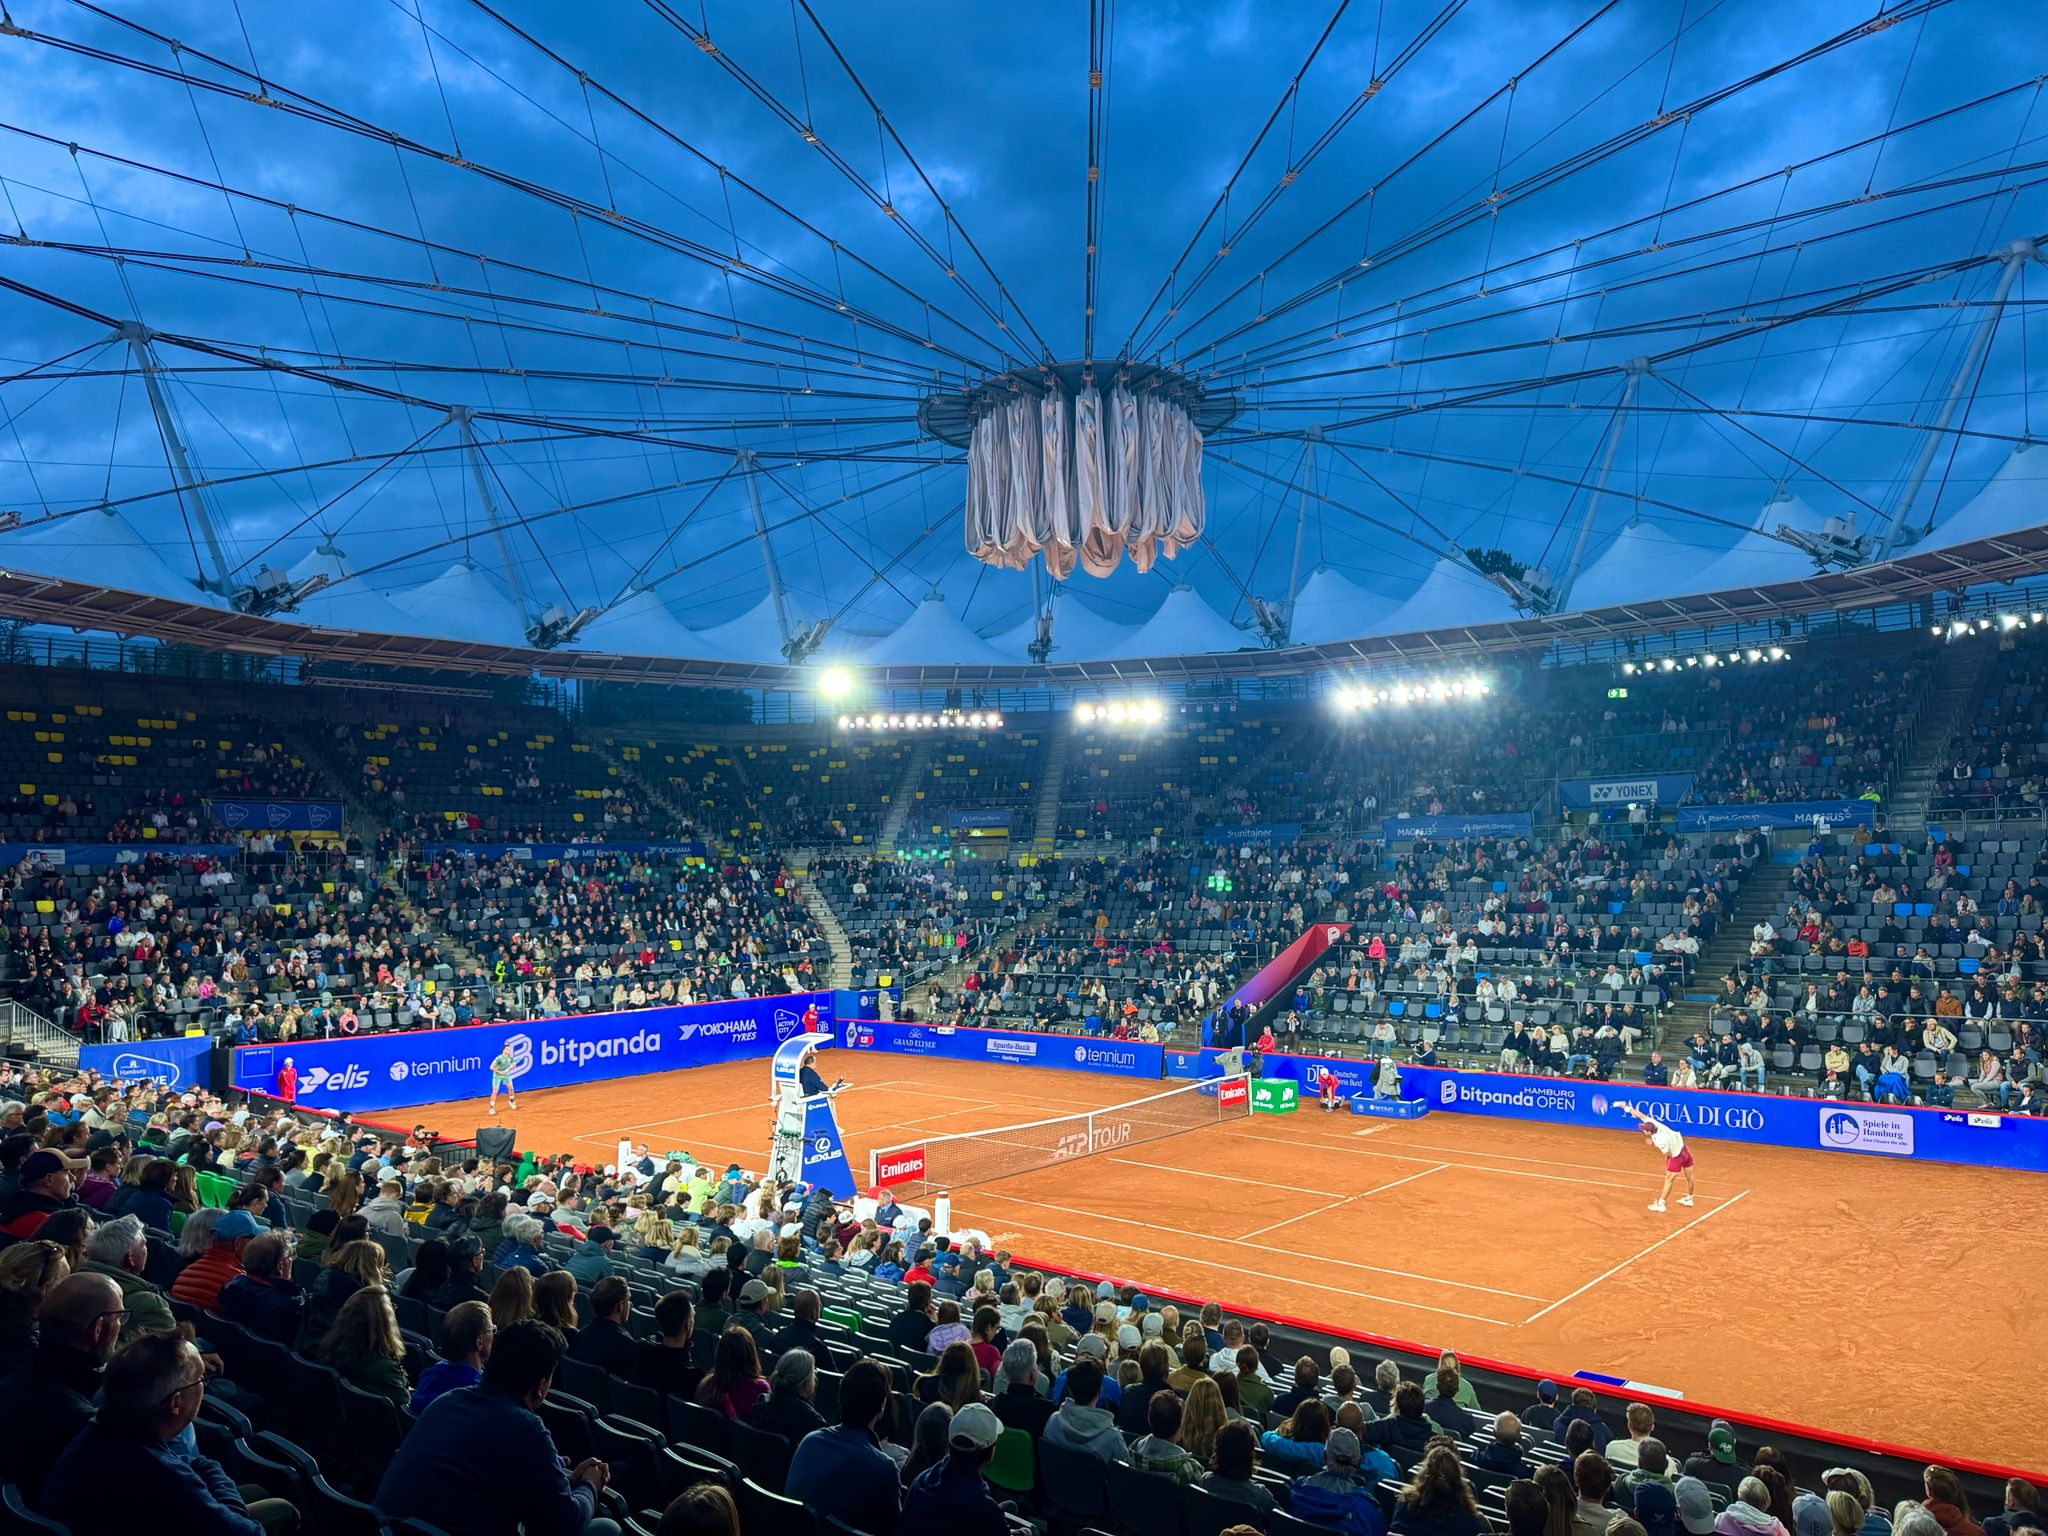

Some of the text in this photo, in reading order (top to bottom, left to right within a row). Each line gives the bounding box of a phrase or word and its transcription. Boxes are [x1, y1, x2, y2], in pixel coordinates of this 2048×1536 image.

[1616, 784, 1653, 798] YONEX
[1234, 828, 1272, 838] unitainer
[698, 1018, 757, 1036] YOKOHAMA
[777, 1020, 795, 1028] ACTIVE
[778, 1026, 790, 1034] CITY
[731, 1031, 757, 1043] TYRES
[541, 1028, 661, 1068] bitpanda
[893, 1038, 936, 1049] GRAND ELYSEE
[993, 1040, 1031, 1052] Sparda-Bank
[1001, 1054, 1020, 1062] Hamburg
[1088, 1048, 1135, 1065] tennium
[120, 1068, 147, 1076] Hamburg
[411, 1056, 481, 1077] tennium
[326, 1063, 370, 1091] elis
[1334, 1069, 1359, 1079] Deutscher
[1349, 1078, 1363, 1087] Bund
[1221, 1087, 1247, 1101] Emirates
[1524, 1086, 1575, 1098] HAMBURG
[1460, 1086, 1575, 1111] bitpanda OPEN
[1697, 1105, 1721, 1126] DI
[1724, 1107, 1764, 1131] GIÒ
[1863, 1119, 1900, 1130] Spiele in
[1053, 1122, 1131, 1158] ATP TOUR
[1863, 1128, 1904, 1140] Hamburg
[804, 1149, 843, 1165] LEXUS
[881, 1158, 924, 1179] Emirates
